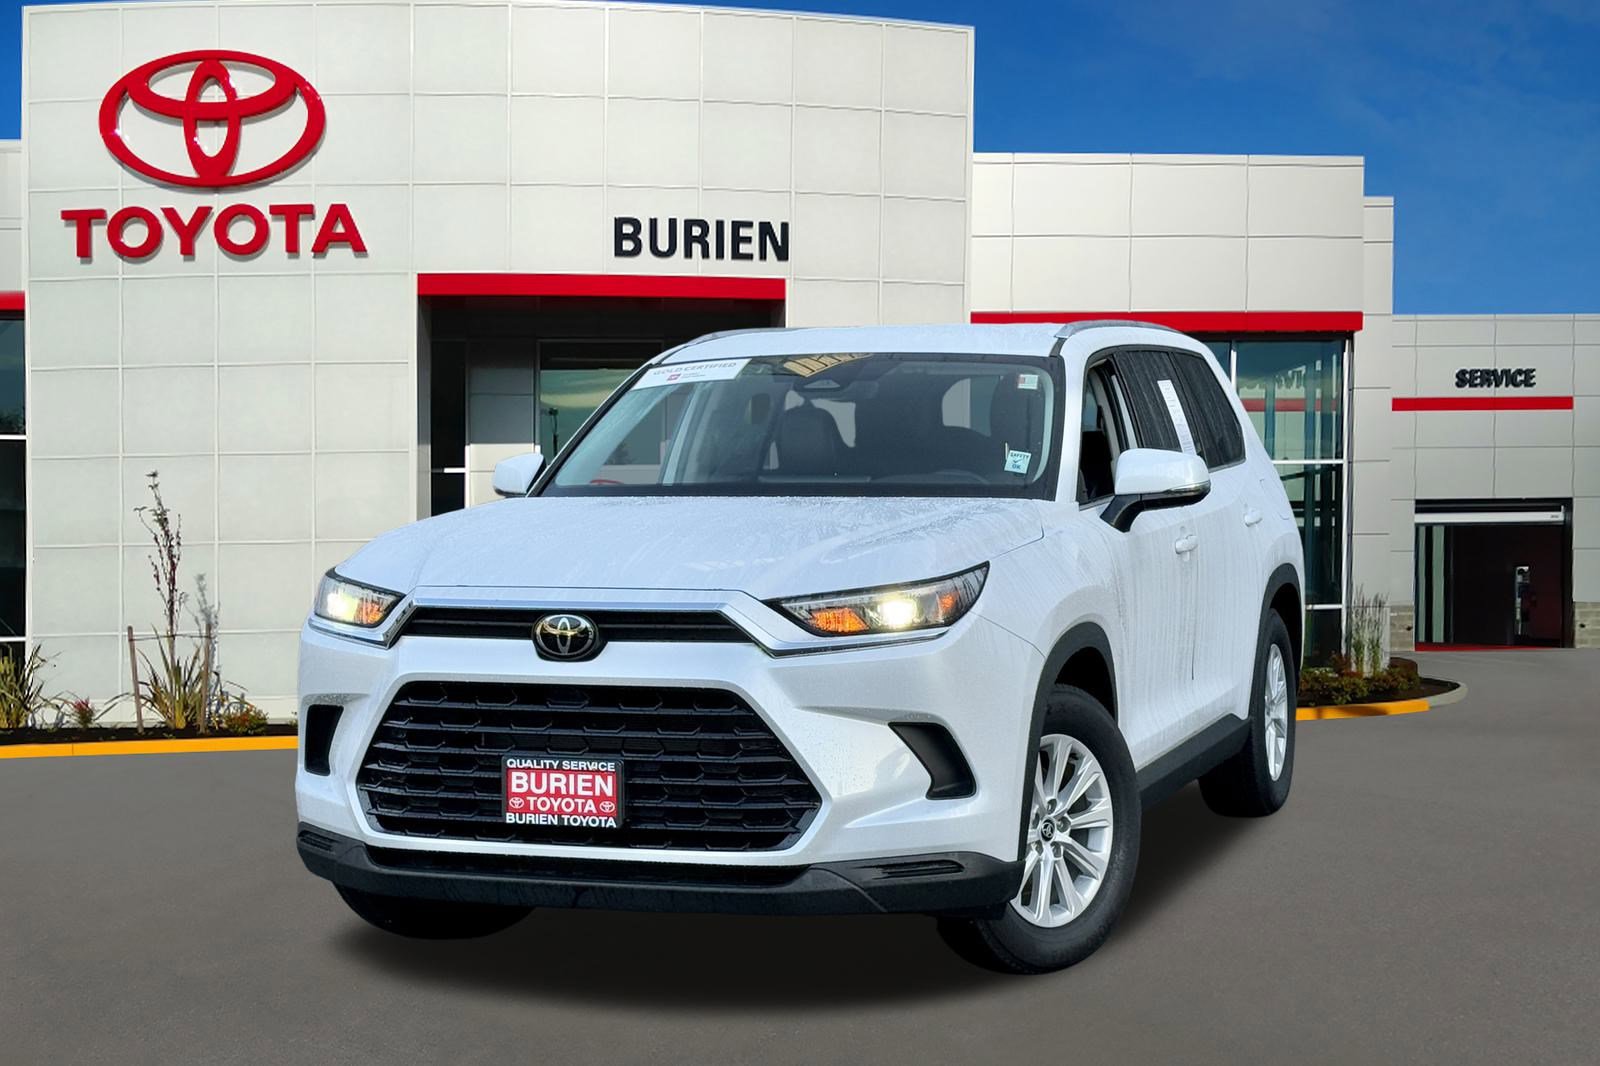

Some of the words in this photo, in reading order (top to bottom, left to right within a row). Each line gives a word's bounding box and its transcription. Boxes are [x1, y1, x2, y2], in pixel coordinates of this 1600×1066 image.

[61, 204, 367, 258] TOYOTA
[614, 217, 790, 261] BURIEN
[684, 362, 736, 371] CERTIFIED
[1455, 368, 1536, 388] SERVICE
[506, 759, 559, 769] QUALITY
[562, 760, 615, 771] SERVICE
[511, 771, 613, 797] BURIEN
[526, 796, 597, 814] TOYOTA
[505, 813, 558, 825] BURIEN
[561, 814, 617, 828] TOYOTA
